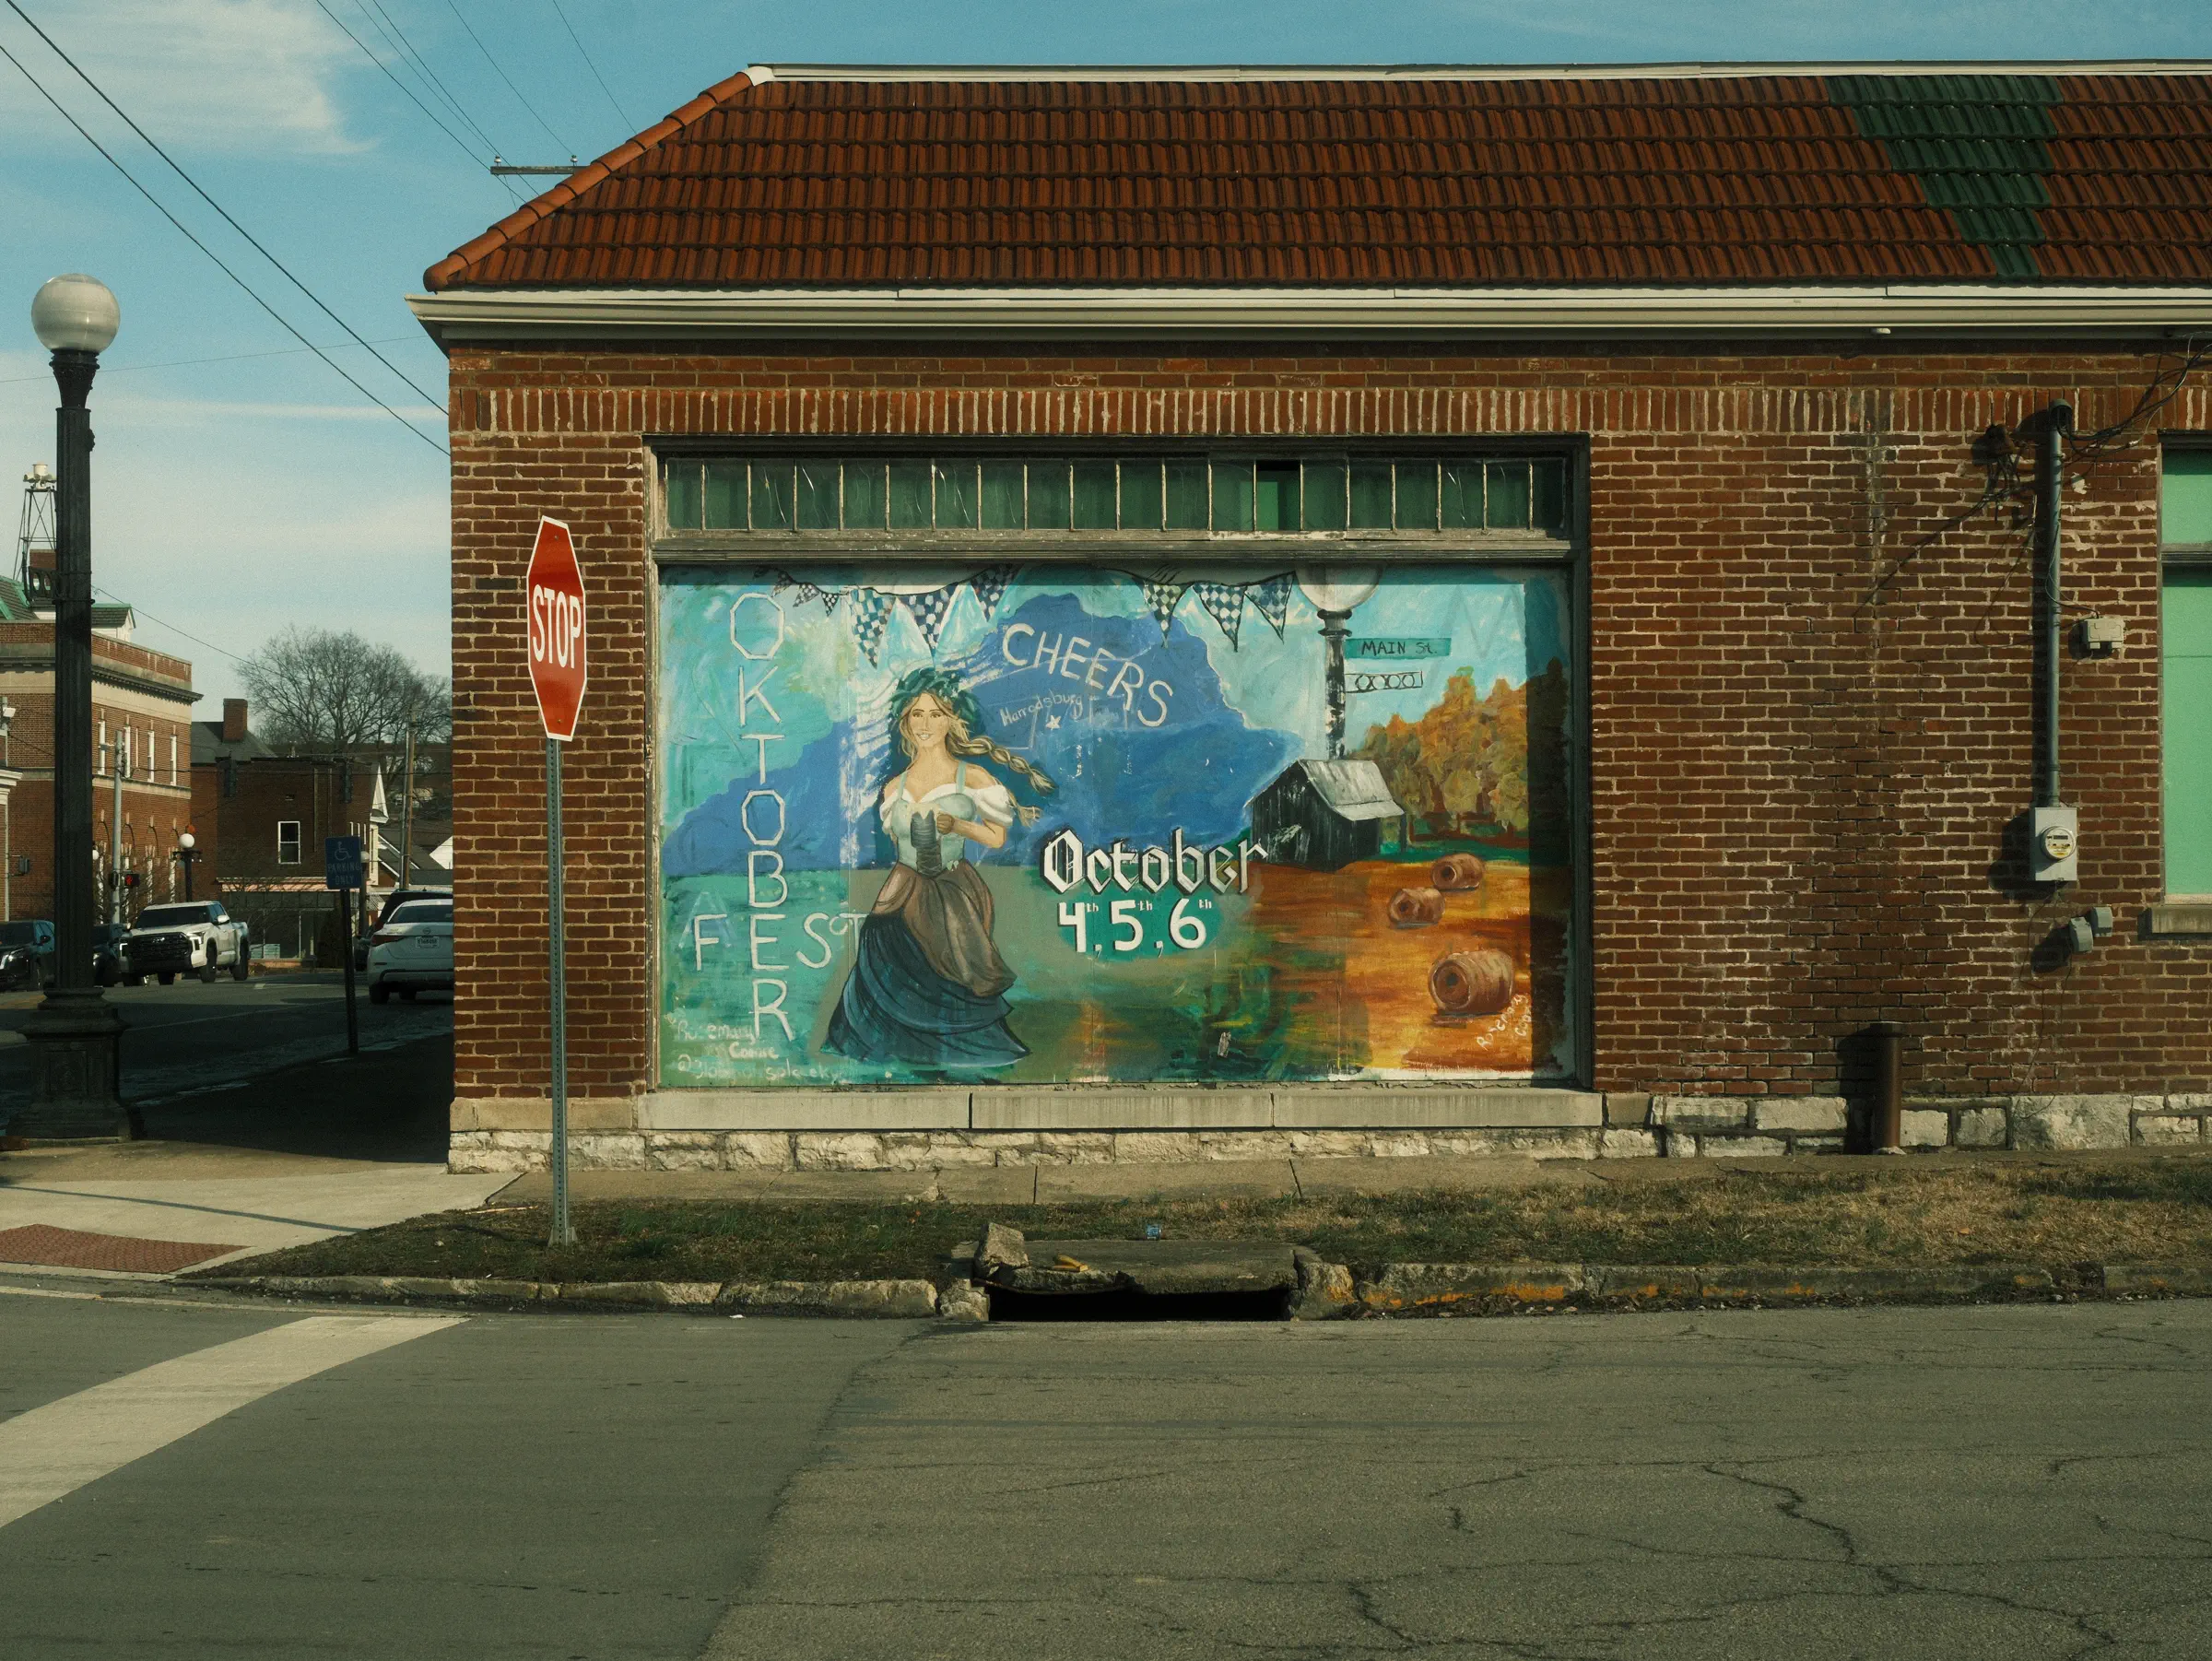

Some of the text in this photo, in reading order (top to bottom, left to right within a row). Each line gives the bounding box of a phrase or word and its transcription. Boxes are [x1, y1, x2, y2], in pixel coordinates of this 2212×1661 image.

[533, 584, 582, 669] STOP
[1361, 640, 1406, 656] MAIN
[1002, 622, 1173, 727] CHEERS
[1000, 689, 1084, 726] Harrodsburg
[730, 593, 794, 1043] OKTOBER
[327, 862, 360, 873] PARKING
[335, 875, 354, 886] ONLY
[1042, 827, 1269, 894] October
